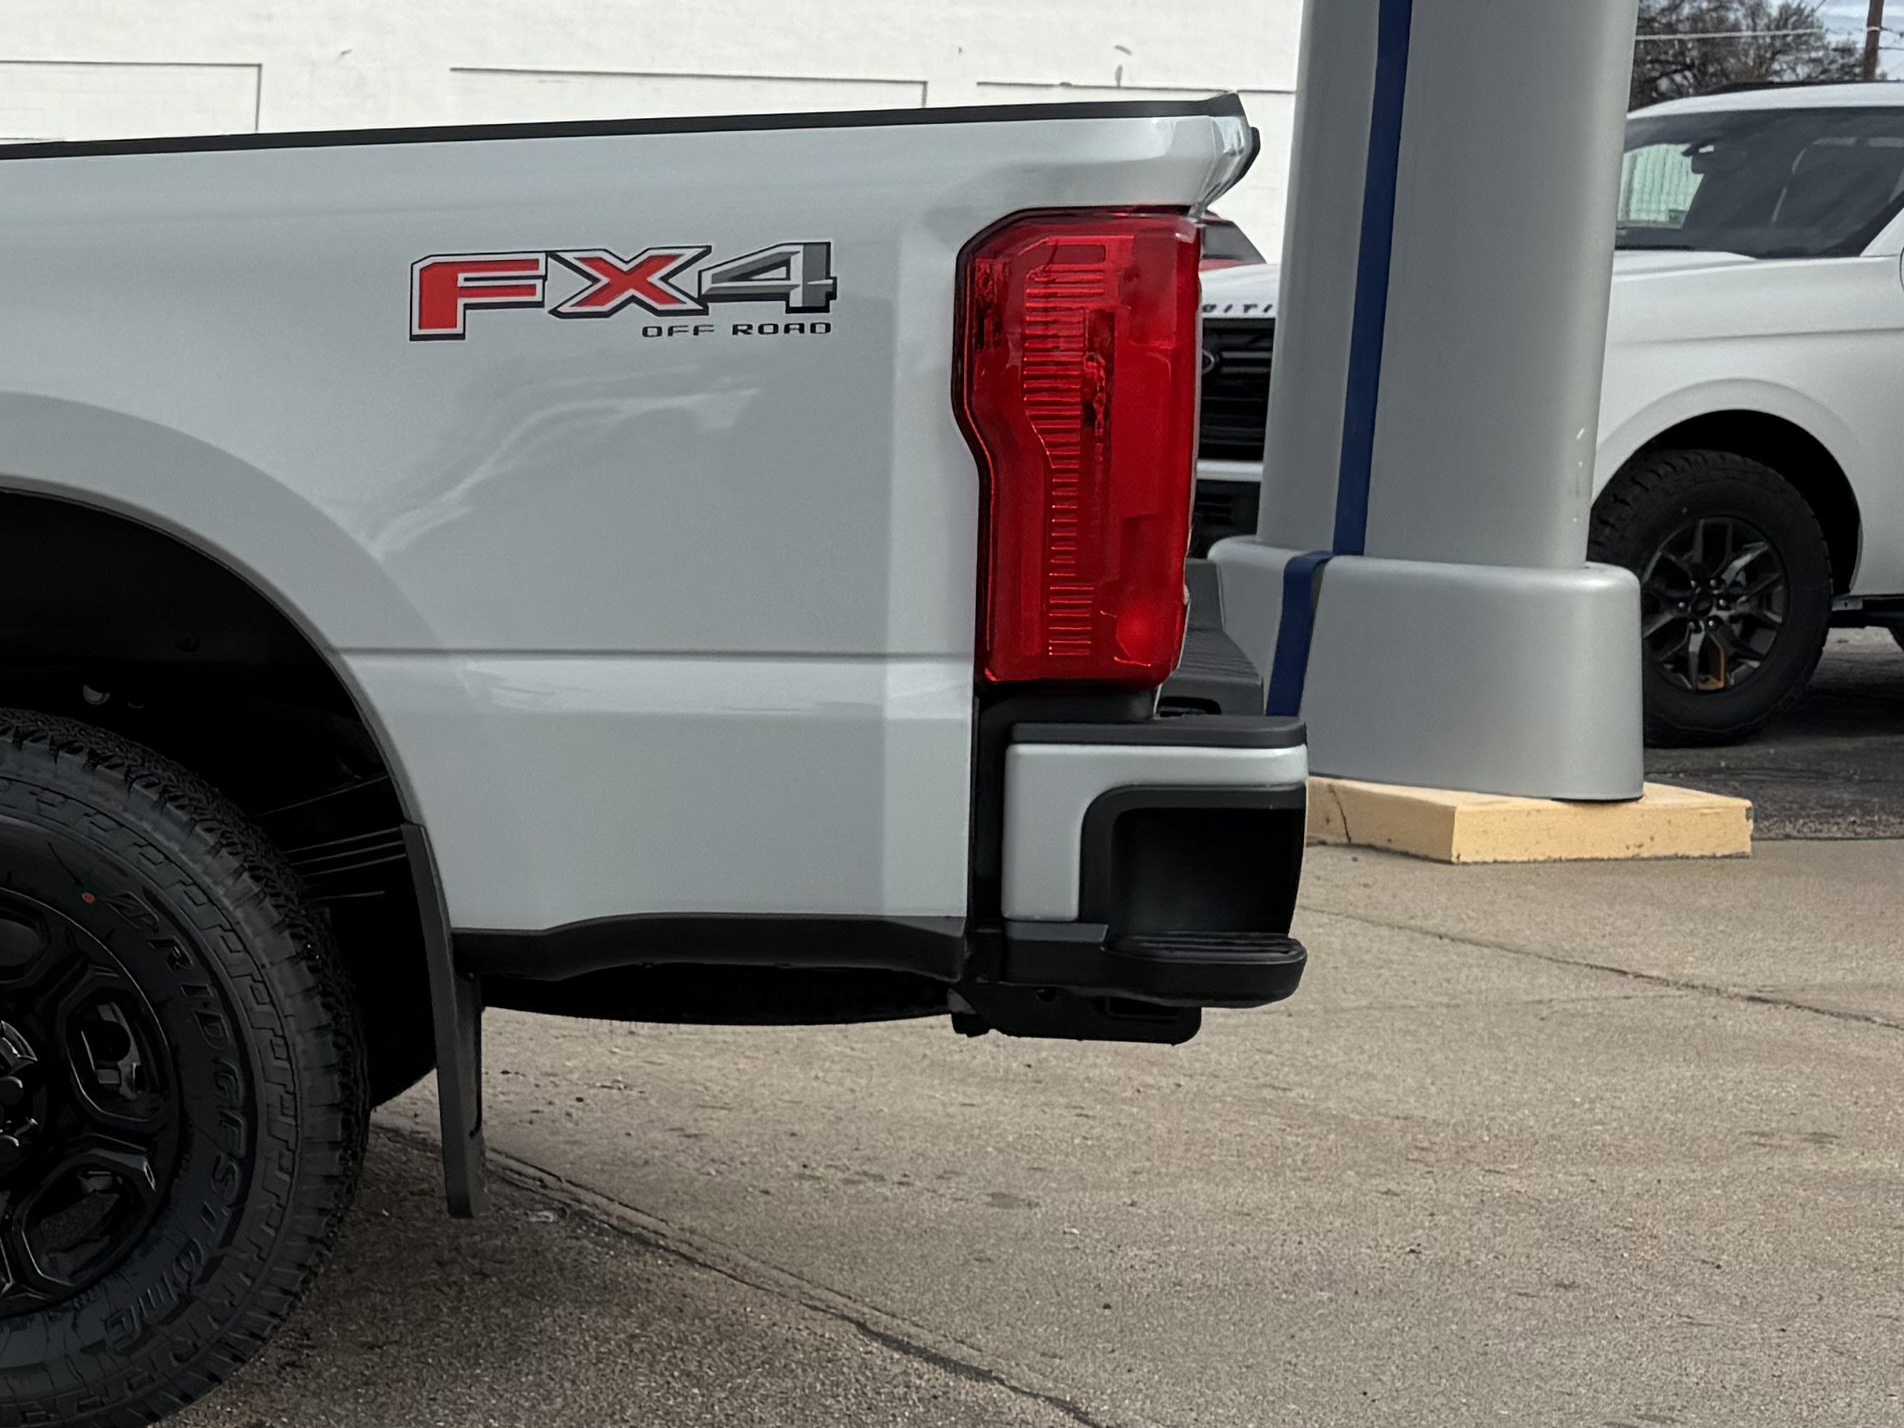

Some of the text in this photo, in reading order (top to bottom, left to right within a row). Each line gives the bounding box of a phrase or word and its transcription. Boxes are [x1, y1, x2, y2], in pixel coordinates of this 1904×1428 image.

[409, 241, 838, 341] FX4
[641, 322, 832, 338] OFF ROAD
